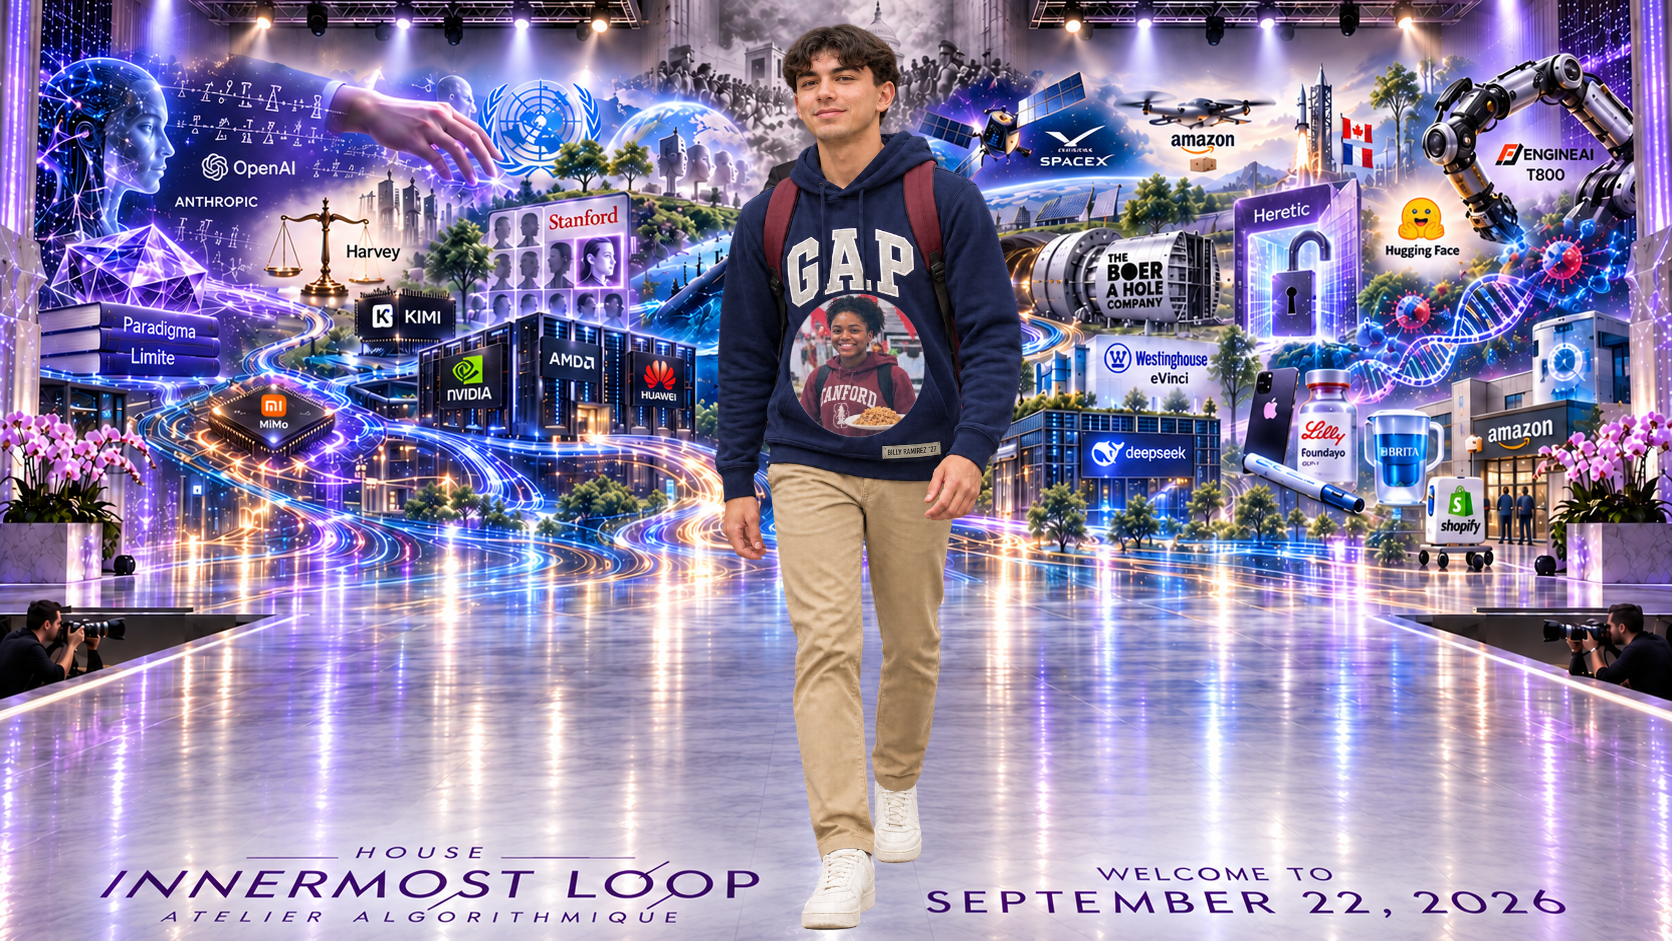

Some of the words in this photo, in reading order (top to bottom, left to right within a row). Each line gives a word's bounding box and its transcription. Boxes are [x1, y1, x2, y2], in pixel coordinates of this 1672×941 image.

[1171, 132, 1235, 149] amazon
[1040, 154, 1115, 166] SPACEX
[1523, 148, 1594, 161] ENGINEAI
[234, 160, 295, 180] OpenAI
[1526, 168, 1565, 181] T800
[175, 196, 258, 207] ANTHROPIC
[549, 205, 618, 231] Stanford
[1254, 202, 1310, 223] Heretic
[346, 244, 400, 262] Harvey
[1107, 253, 1128, 263] THE
[1385, 245, 1432, 258] Hugging
[1434, 245, 1460, 256] Face
[787, 227, 914, 307] GAP
[1107, 261, 1163, 281] BOER
[1106, 283, 1118, 298] A
[1123, 281, 1163, 296] HOLE
[1107, 297, 1163, 309] COMPANY
[405, 309, 441, 324] KIMI
[123, 316, 196, 341] Paradigma
[131, 347, 175, 366] Limite
[549, 352, 584, 369] AMD
[1135, 351, 1208, 370] Westinghouse
[1150, 372, 1189, 384] eVinci
[641, 391, 677, 402] HUAWEI
[820, 384, 878, 409] TANFORD
[260, 420, 289, 429] MiMo
[1301, 420, 1346, 446] Lilly
[1487, 419, 1554, 443] amazon
[1125, 446, 1186, 464] deepseek
[1301, 448, 1346, 459] Foundayo
[1389, 447, 1420, 457] BRITA
[1441, 519, 1481, 535] shopify
[355, 846, 485, 859] HOUSE
[1096, 867, 1271, 881] WELCOME
[1286, 867, 1334, 881] TO
[100, 869, 536, 899] INNERMOST
[926, 890, 1277, 914] SEPTEMBER
[1301, 890, 1393, 918] 22,
[1413, 889, 1567, 915] 2026
[160, 911, 323, 924] ATELIER
[352, 911, 681, 924] ALGORITHMIQUE
